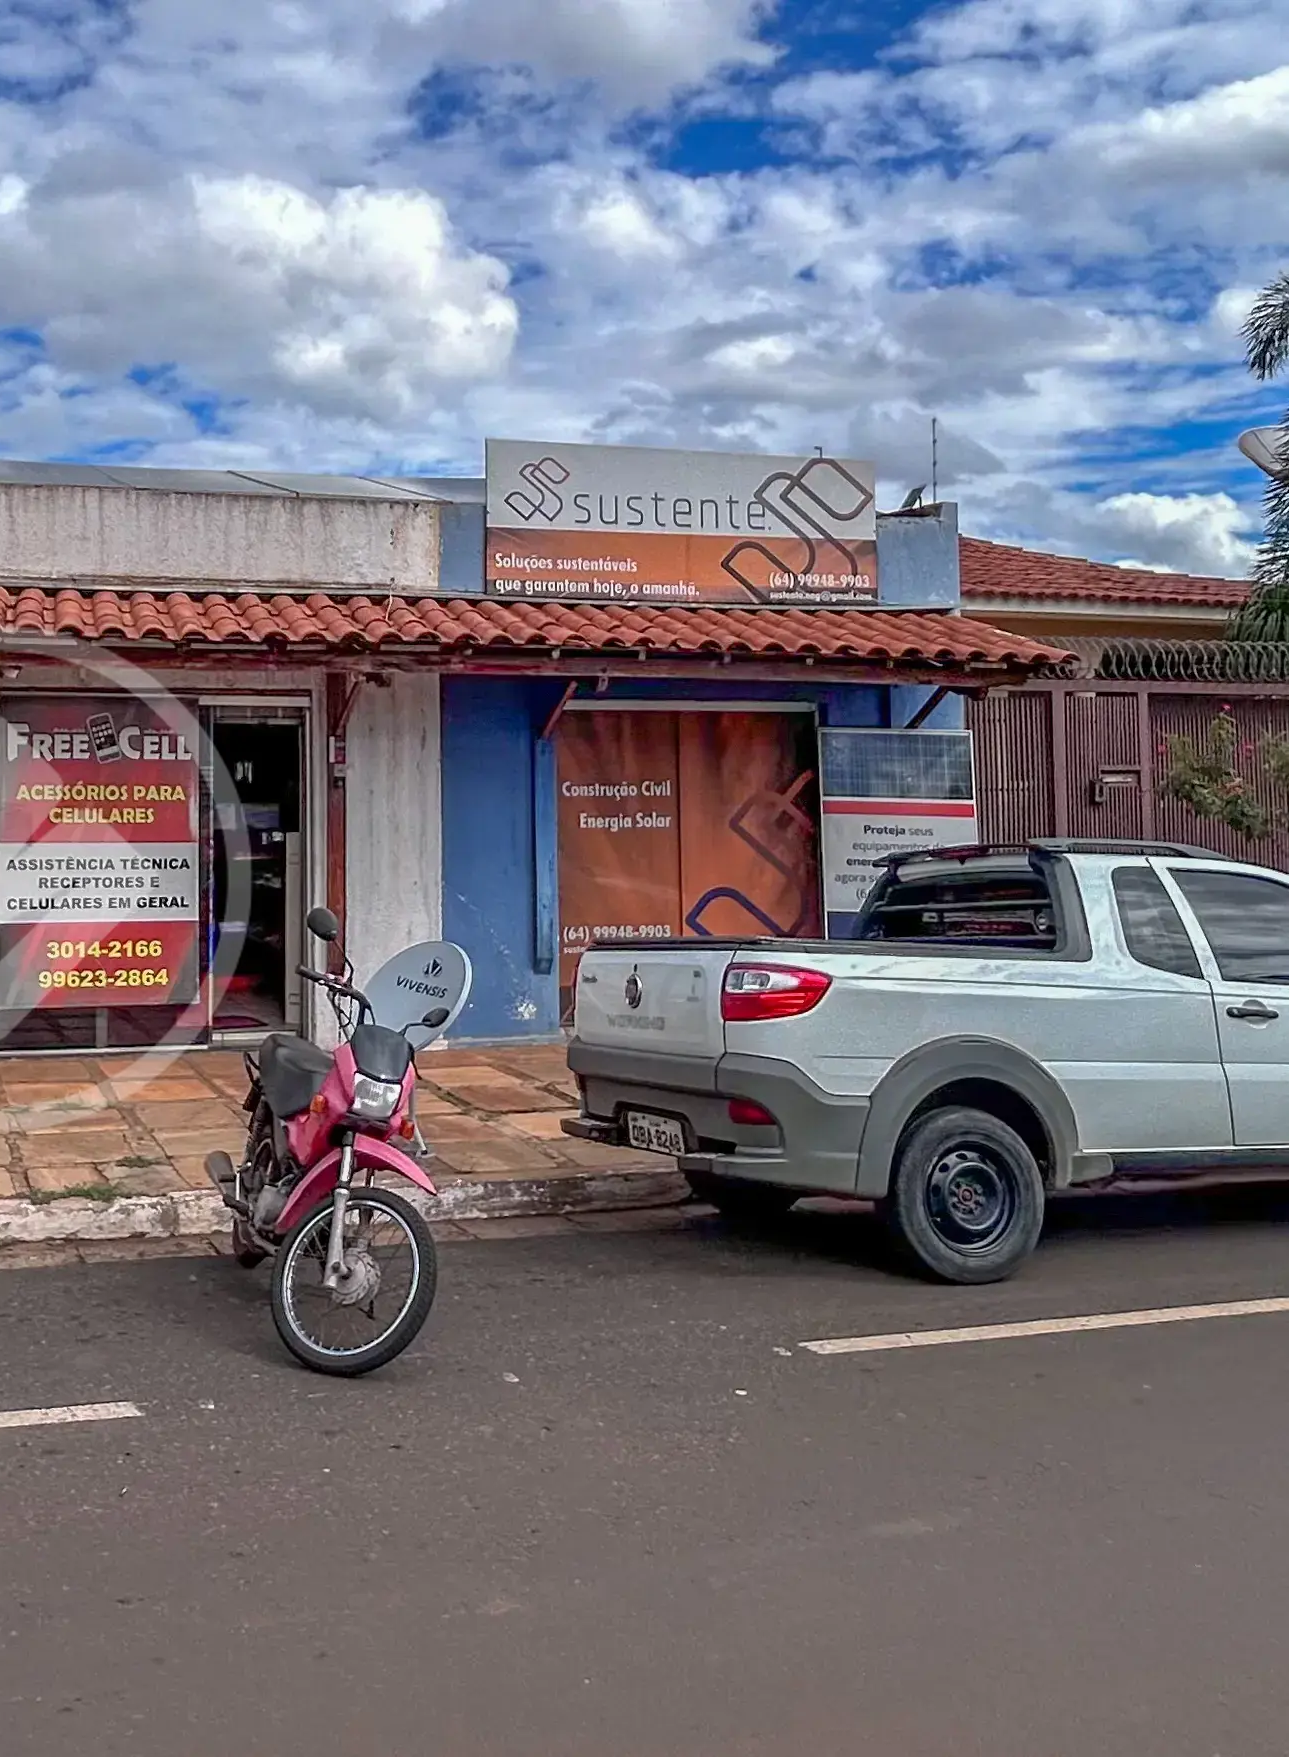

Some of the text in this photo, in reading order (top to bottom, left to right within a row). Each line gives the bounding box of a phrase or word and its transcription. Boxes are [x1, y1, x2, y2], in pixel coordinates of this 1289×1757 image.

[494, 552, 638, 573] Soluções sustentáveis
[495, 578, 522, 594] que
[525, 578, 590, 595] garantem
[769, 571, 870, 589] (64) 99948-9903
[16, 780, 186, 801] ACESSÓRIOS PARA
[562, 779, 671, 801] Construção Civil
[48, 807, 155, 824] CELULARES
[579, 812, 672, 832] Energia Solar
[863, 824, 934, 837] Proteja seus
[852, 841, 929, 852] equipamentos
[6, 855, 191, 871] ASSISTÊNCIA TÉCNICA
[38, 876, 160, 889] RECEPTORES E
[834, 873, 867, 884] agora
[6, 896, 190, 910] CELULARES EM GERAL
[563, 924, 672, 944] (64) 99948-9903
[45, 940, 163, 959] 3014-2166
[38, 968, 170, 989] 99623-2864
[396, 975, 449, 999] VIVENSIS
